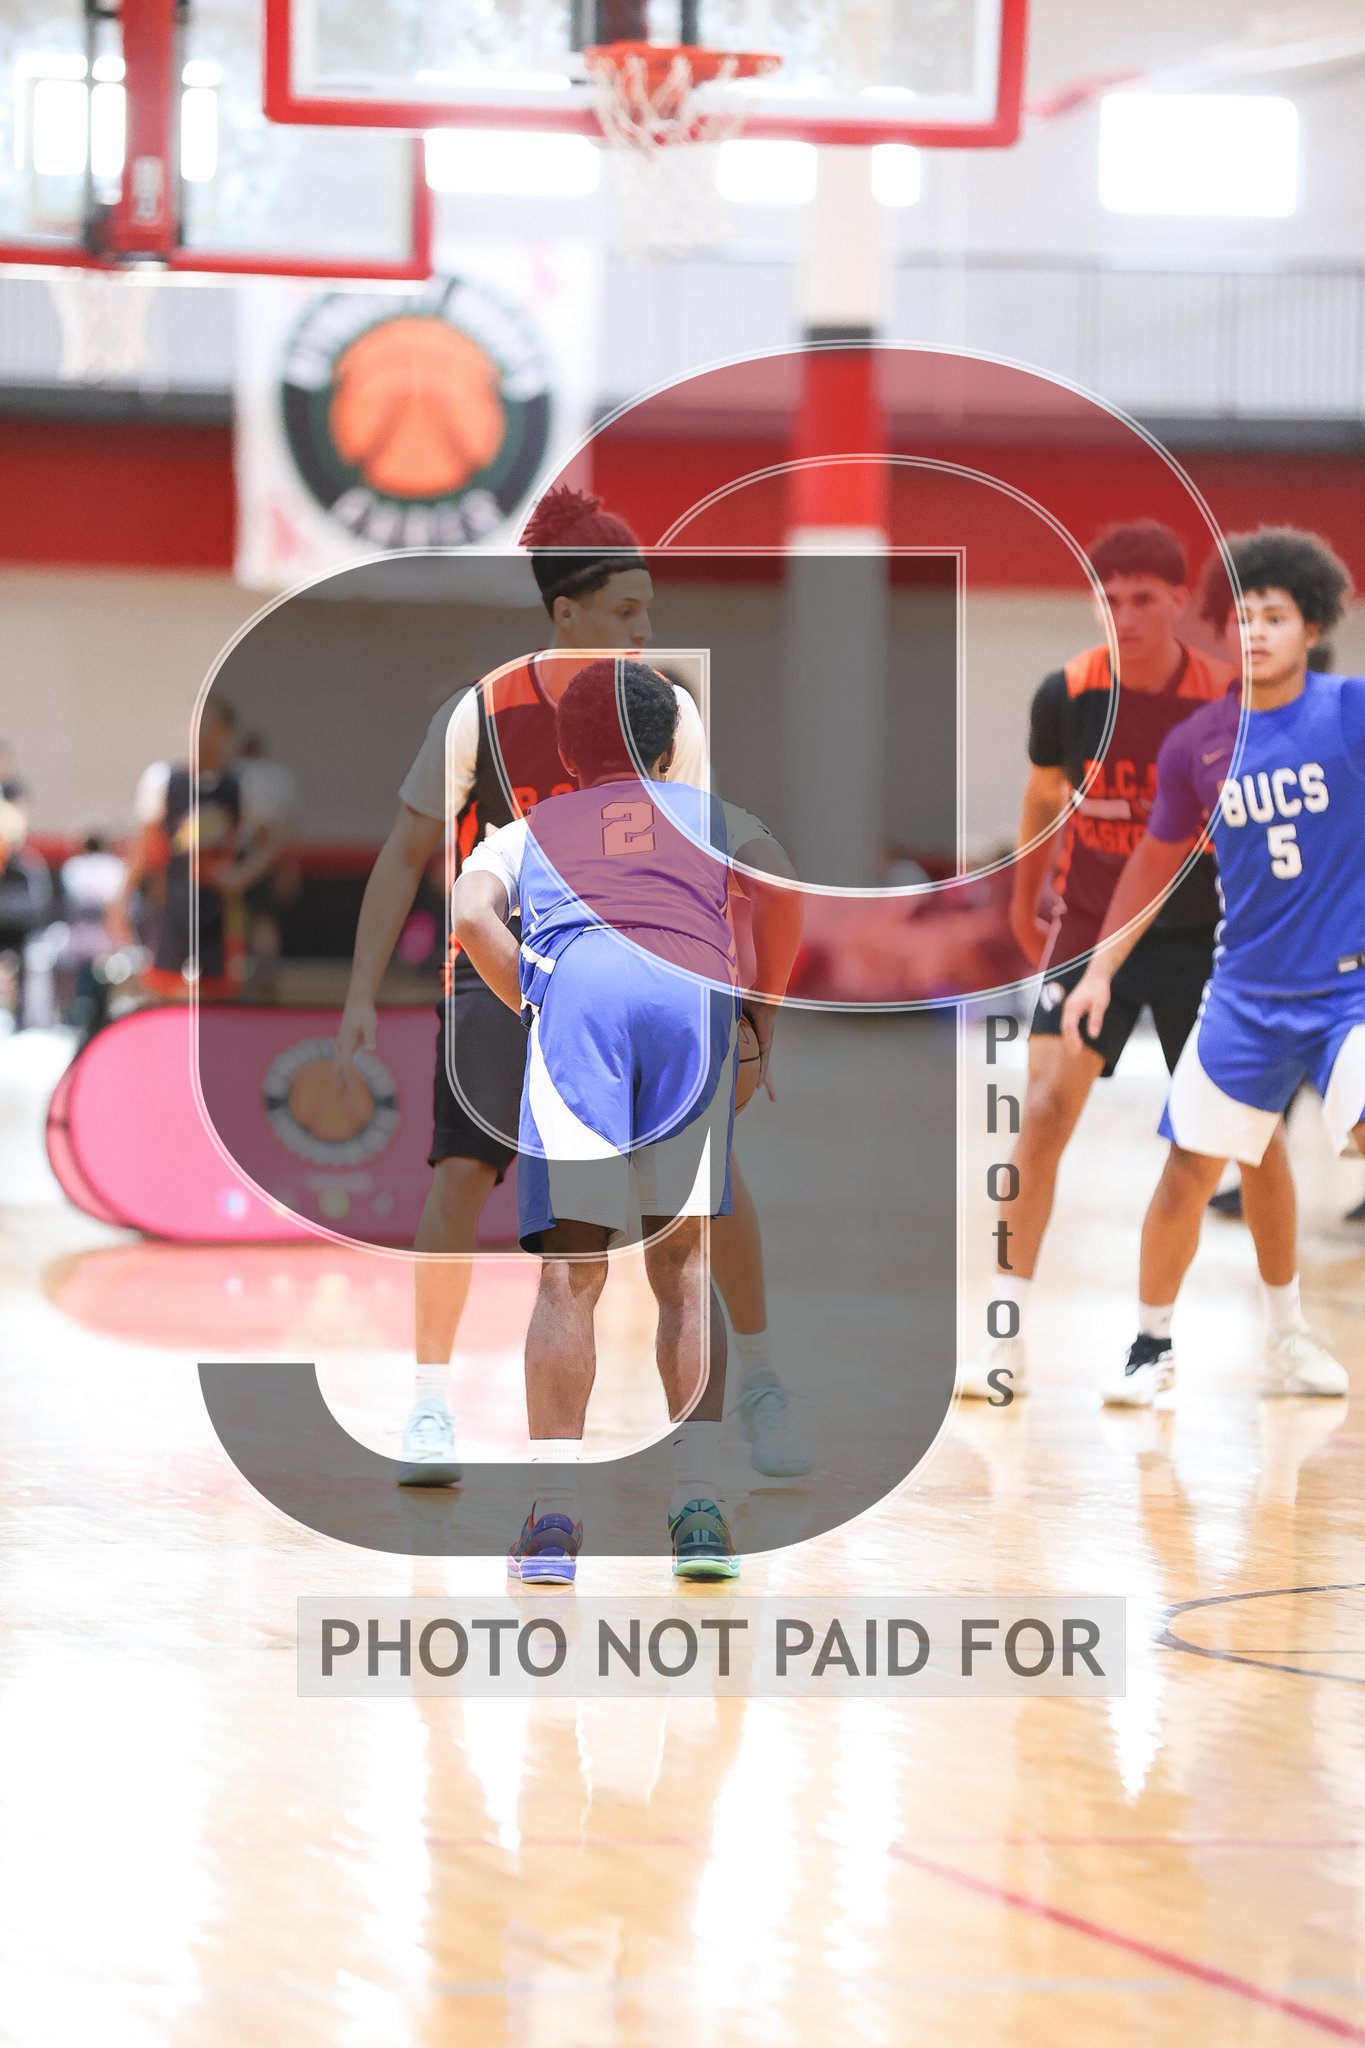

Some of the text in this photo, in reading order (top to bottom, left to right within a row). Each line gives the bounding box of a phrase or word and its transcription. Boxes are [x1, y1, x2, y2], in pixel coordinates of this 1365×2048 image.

[1217, 763, 1330, 828] BUCS
[601, 801, 656, 856] 2
[1266, 823, 1304, 880] 5
